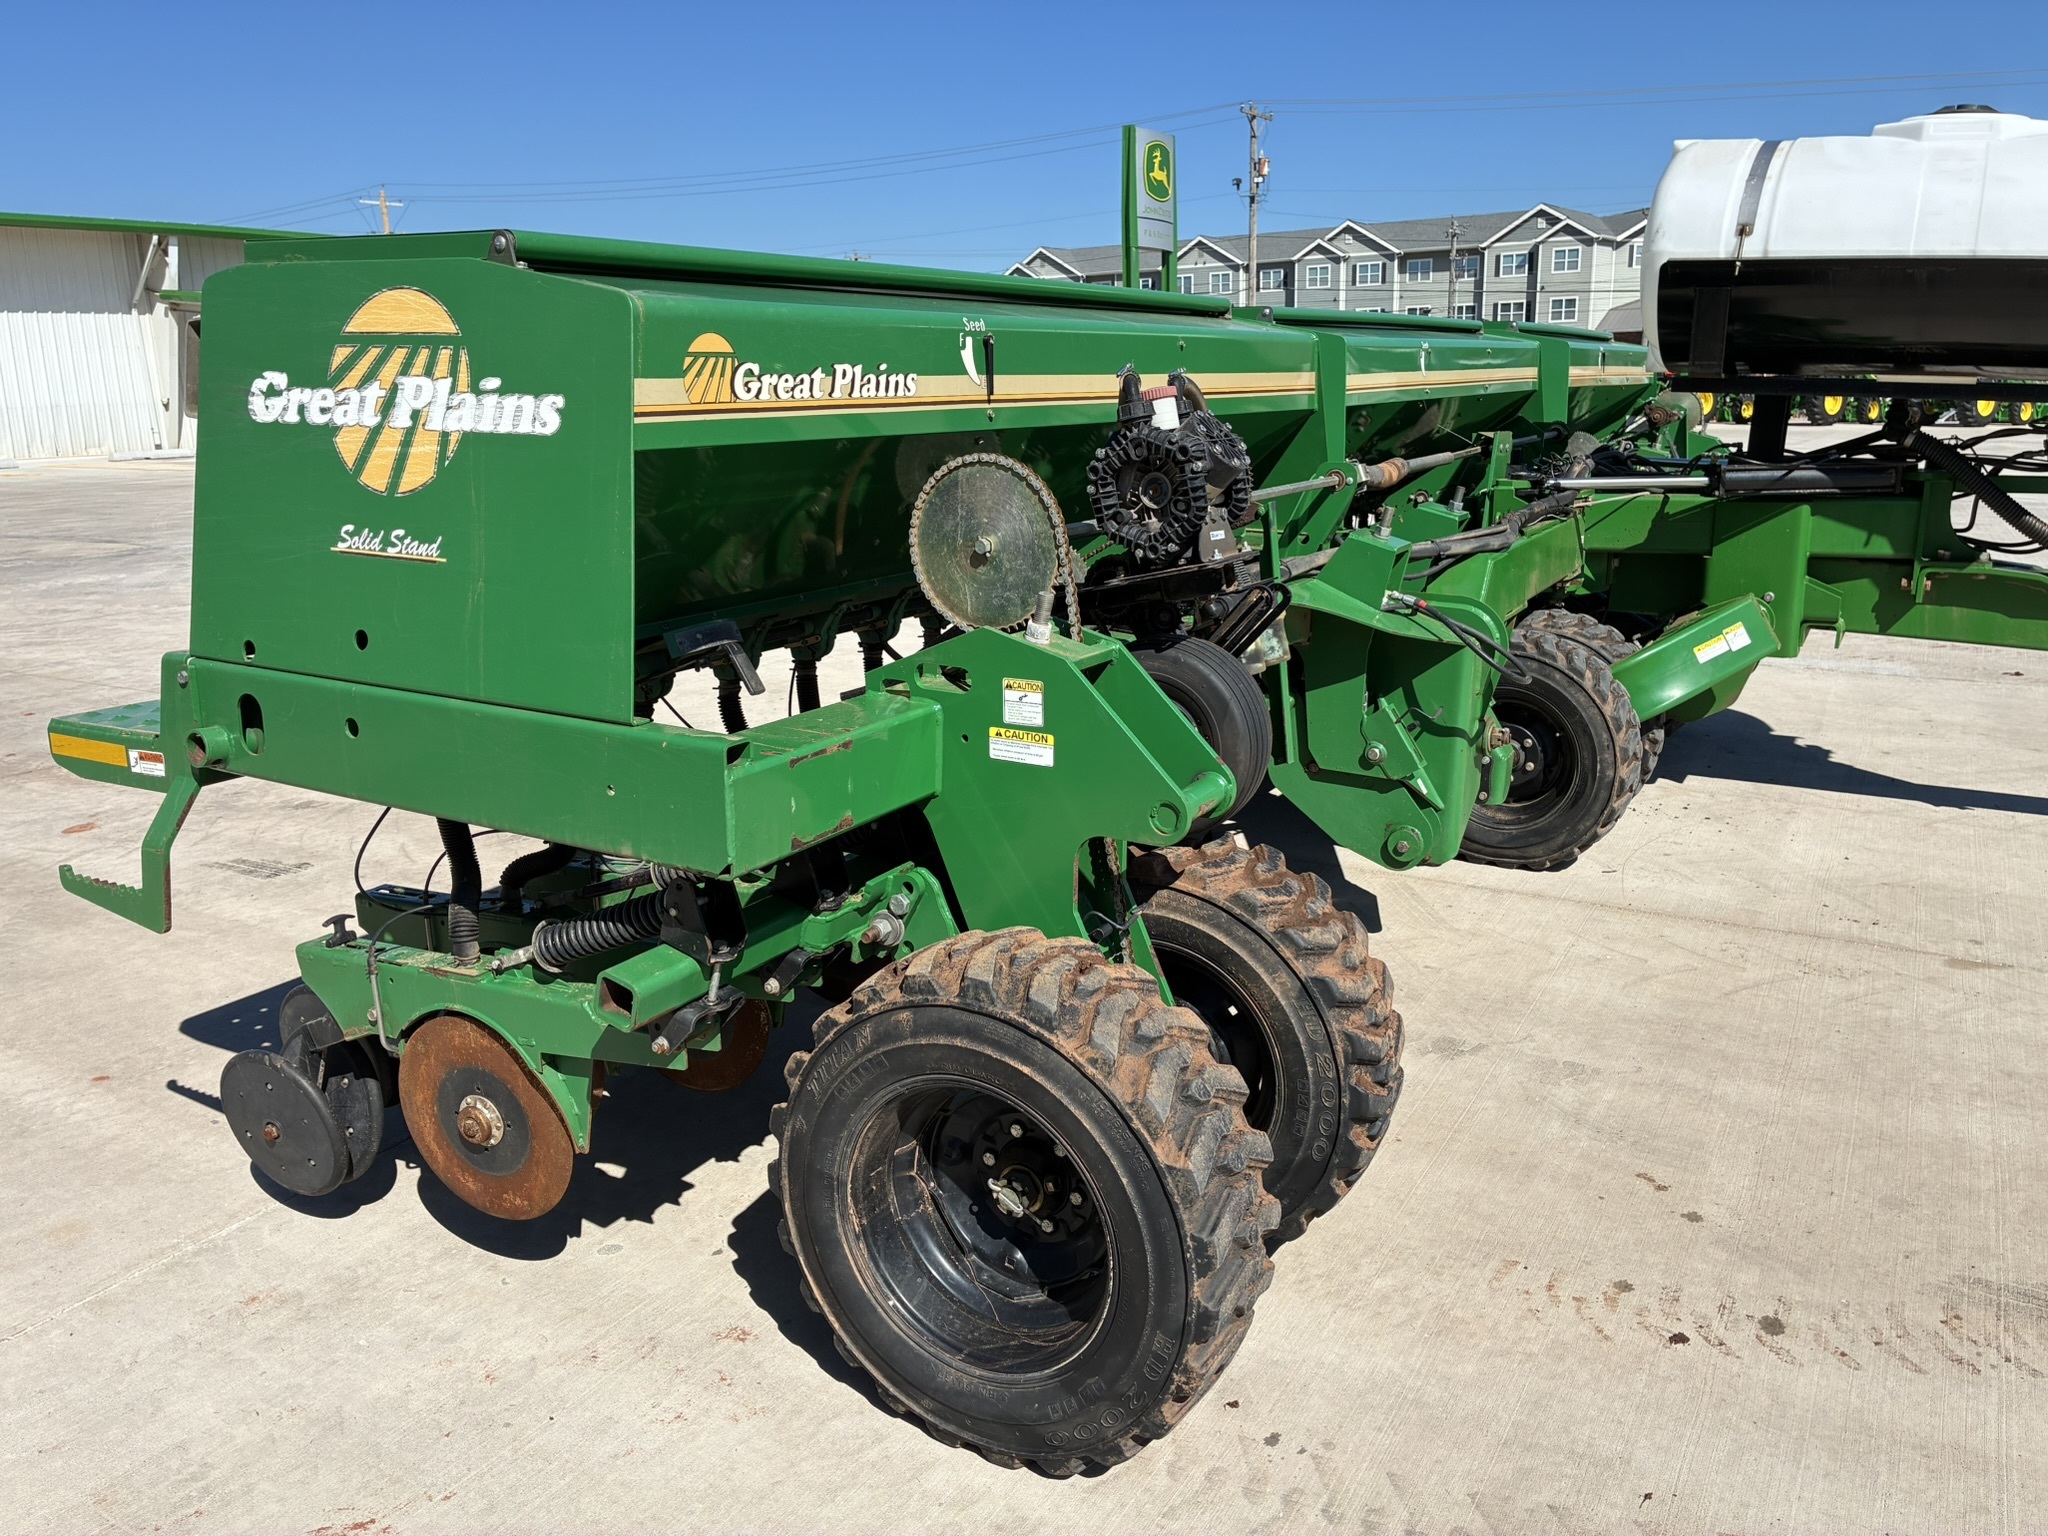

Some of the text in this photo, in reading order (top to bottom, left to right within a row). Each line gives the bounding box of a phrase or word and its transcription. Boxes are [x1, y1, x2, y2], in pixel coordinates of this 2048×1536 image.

[959, 332, 964, 347] F
[962, 317, 986, 331] Seed
[732, 362, 918, 401] Great Plains
[247, 371, 566, 435] Great Plains
[337, 524, 442, 558] Solid Stand
[1012, 681, 1042, 691] CAUTION
[1004, 729, 1048, 743] CAUTION
[807, 1023, 872, 1100] TITAN
[1311, 1052, 1337, 1162] 2000
[1143, 1330, 1176, 1381] HD
[1044, 1381, 1148, 1447] 2000
